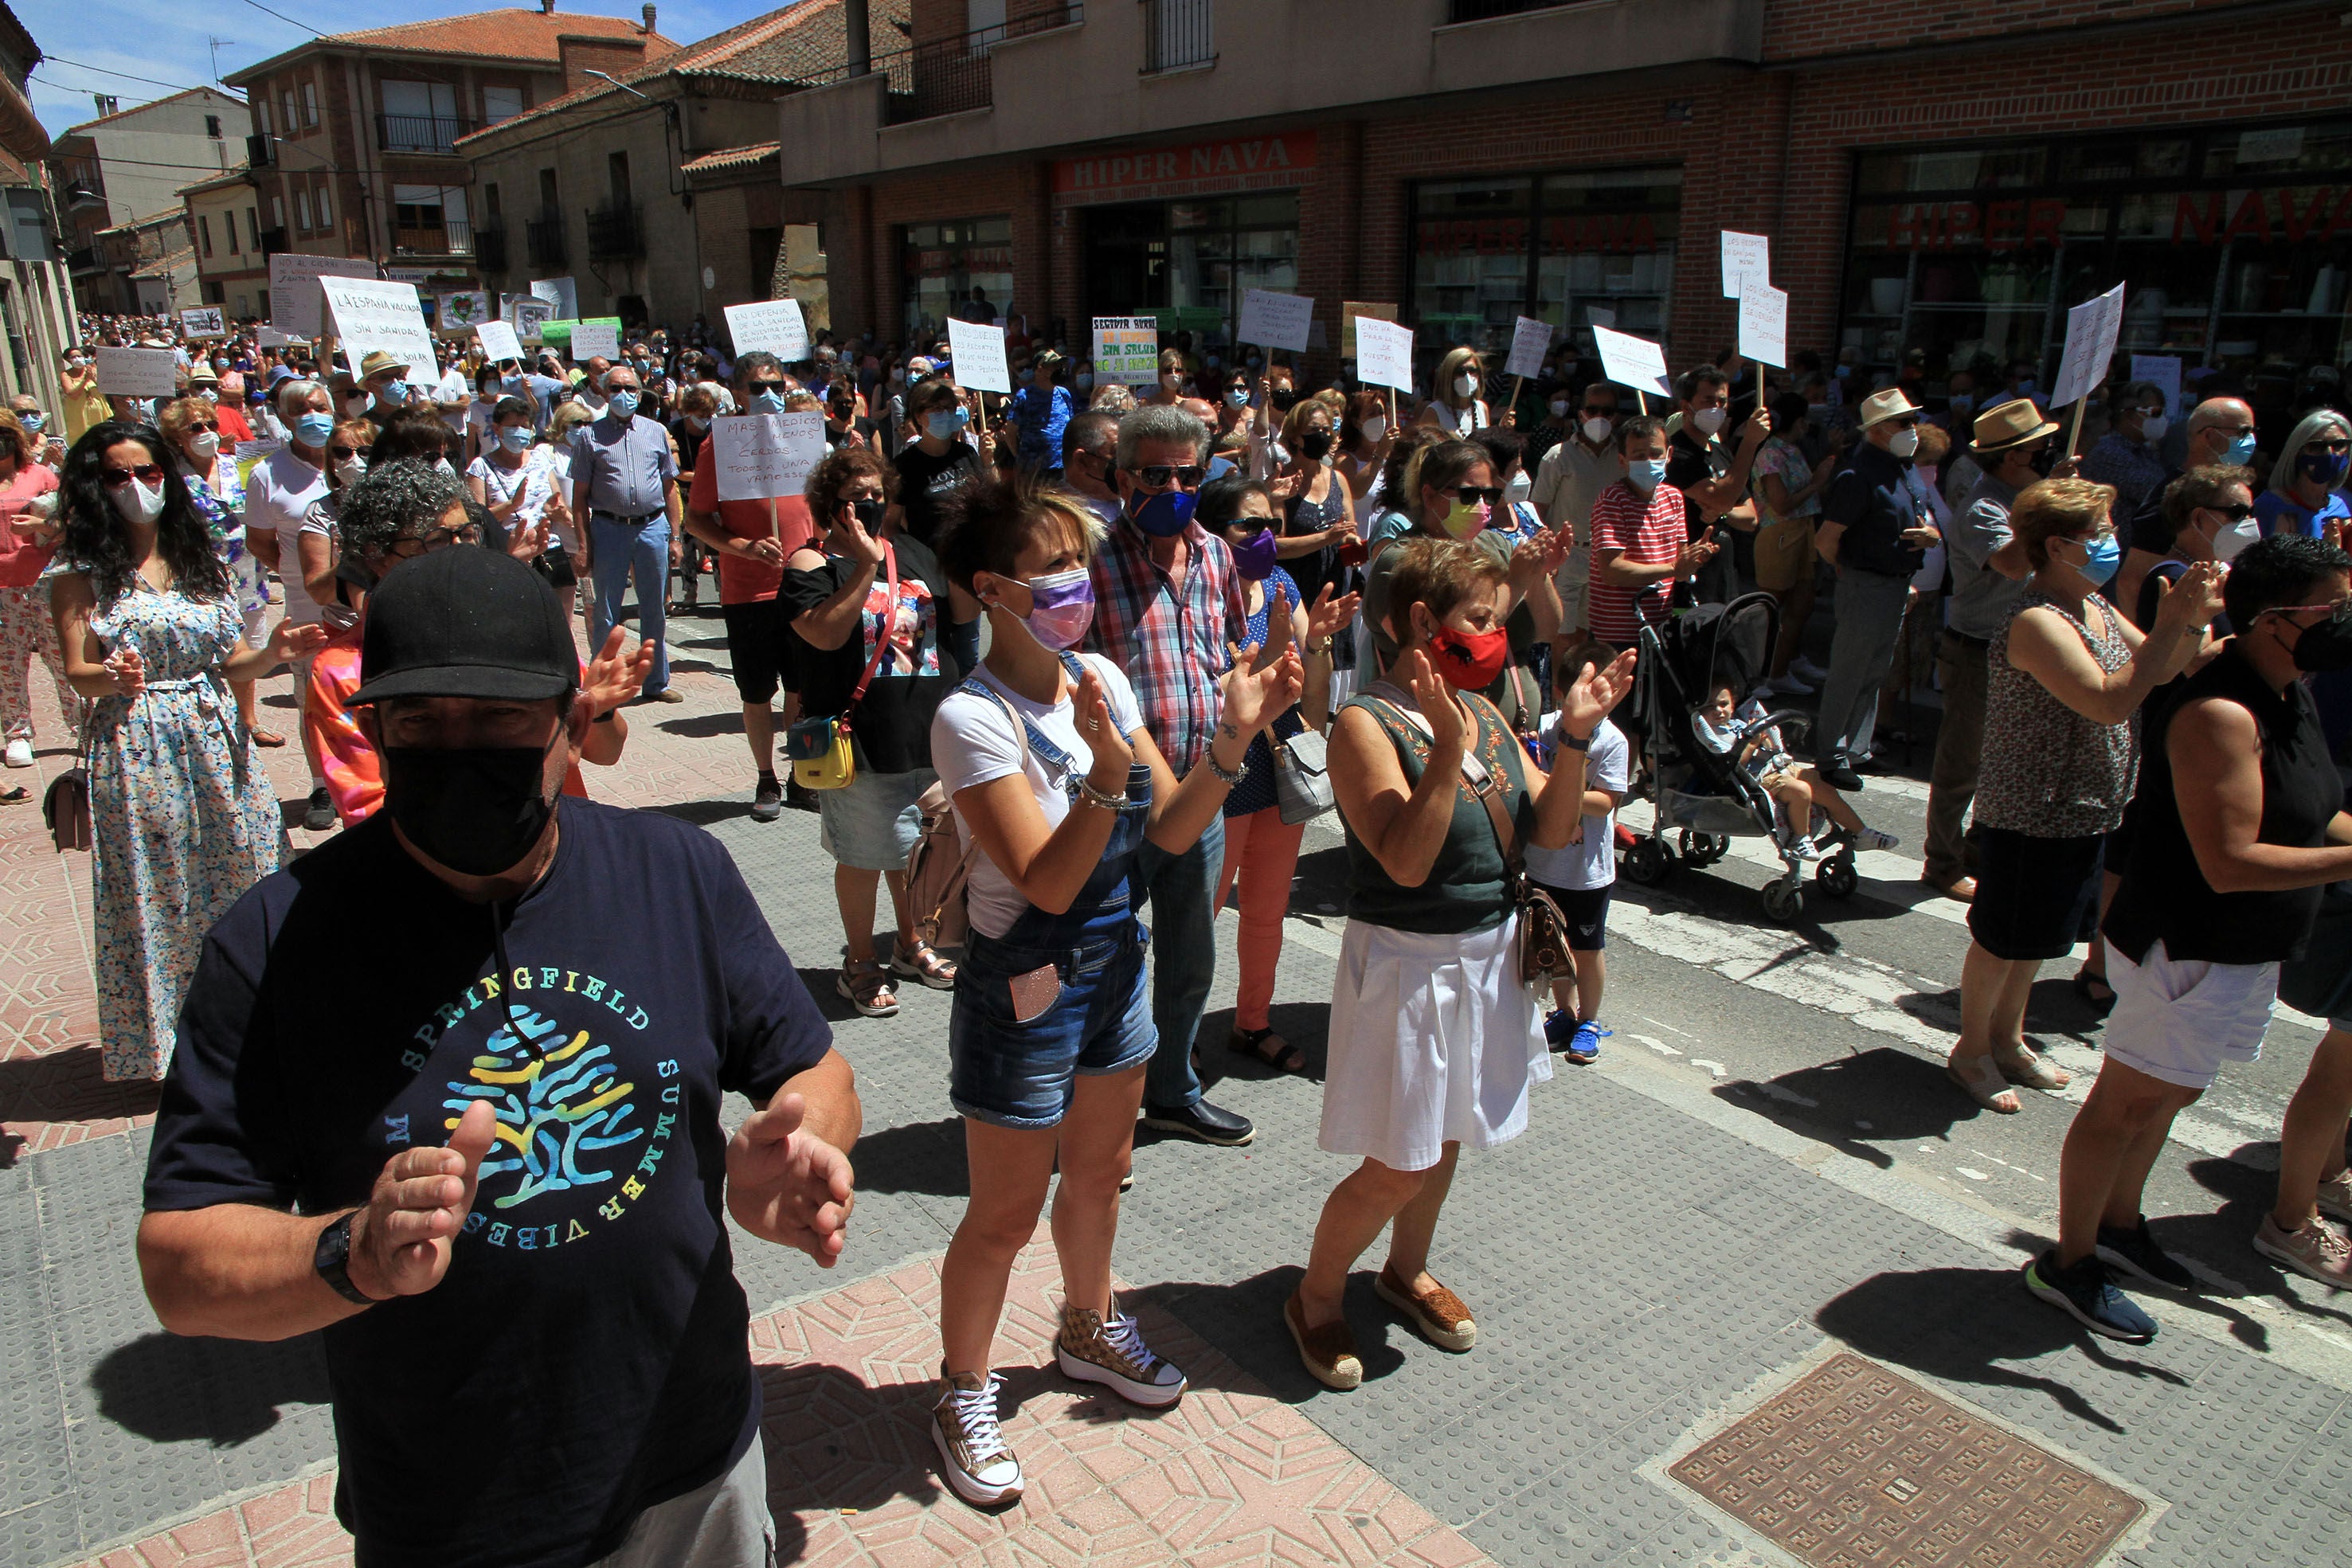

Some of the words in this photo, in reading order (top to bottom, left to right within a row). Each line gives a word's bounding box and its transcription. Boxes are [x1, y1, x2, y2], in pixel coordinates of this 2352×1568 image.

[1074, 151, 1177, 188] HIPER
[1190, 138, 1291, 176] NAVA
[1888, 199, 2067, 252] HIPER
[2172, 187, 2352, 246] NAVA
[1418, 218, 1525, 256] HIPER
[1551, 214, 1658, 254] NAVA
[279, 259, 292, 268] NO
[734, 312, 748, 321] EN
[751, 307, 789, 319] DEFENSA
[767, 316, 802, 327] SANIDAD
[355, 323, 373, 334] SIN
[378, 325, 420, 338] SANIDAD
[750, 327, 781, 336] NUESTRA
[782, 323, 802, 332] ZONA
[785, 330, 806, 340] SALUD
[1102, 343, 1121, 356] SIN
[1124, 343, 1156, 355] SALUD
[403, 352, 429, 364] SOLAR
[1094, 358, 1110, 372] NO
[770, 416, 823, 432] MEDICOS
[773, 430, 815, 440] MENOS
[727, 464, 762, 473] TODOS
[782, 459, 811, 469] UNA
[401, 966, 651, 1073] SPRINGFIELD
[598, 1058, 681, 1221] SUMMER
[462, 1210, 589, 1249] VIBES
